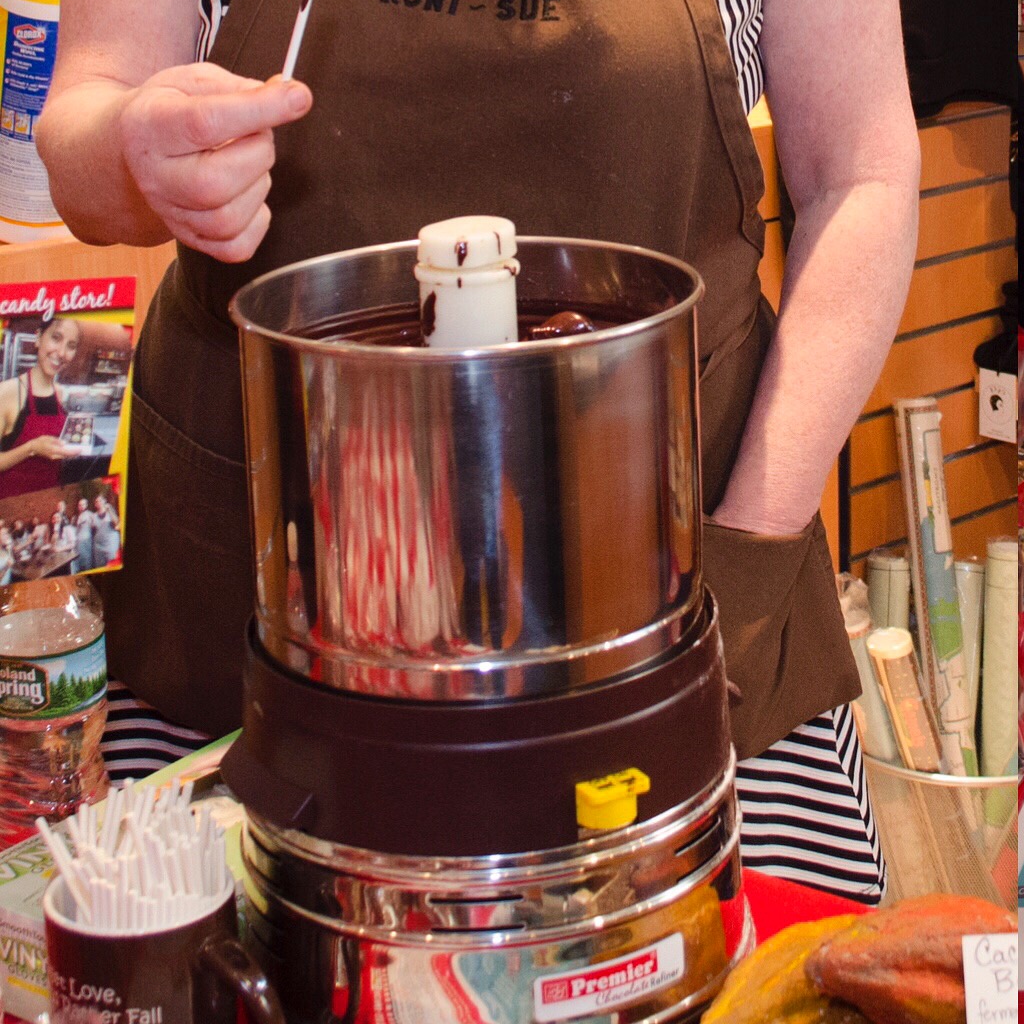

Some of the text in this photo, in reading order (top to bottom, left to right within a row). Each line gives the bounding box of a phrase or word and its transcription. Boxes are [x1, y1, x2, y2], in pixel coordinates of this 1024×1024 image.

[0, 283, 115, 321] candy store!
[70, 977, 123, 1006] Love,
[571, 950, 658, 996] Premier
[595, 965, 680, 1006] Chocolate Refiner
[126, 1006, 164, 1024] Fall
